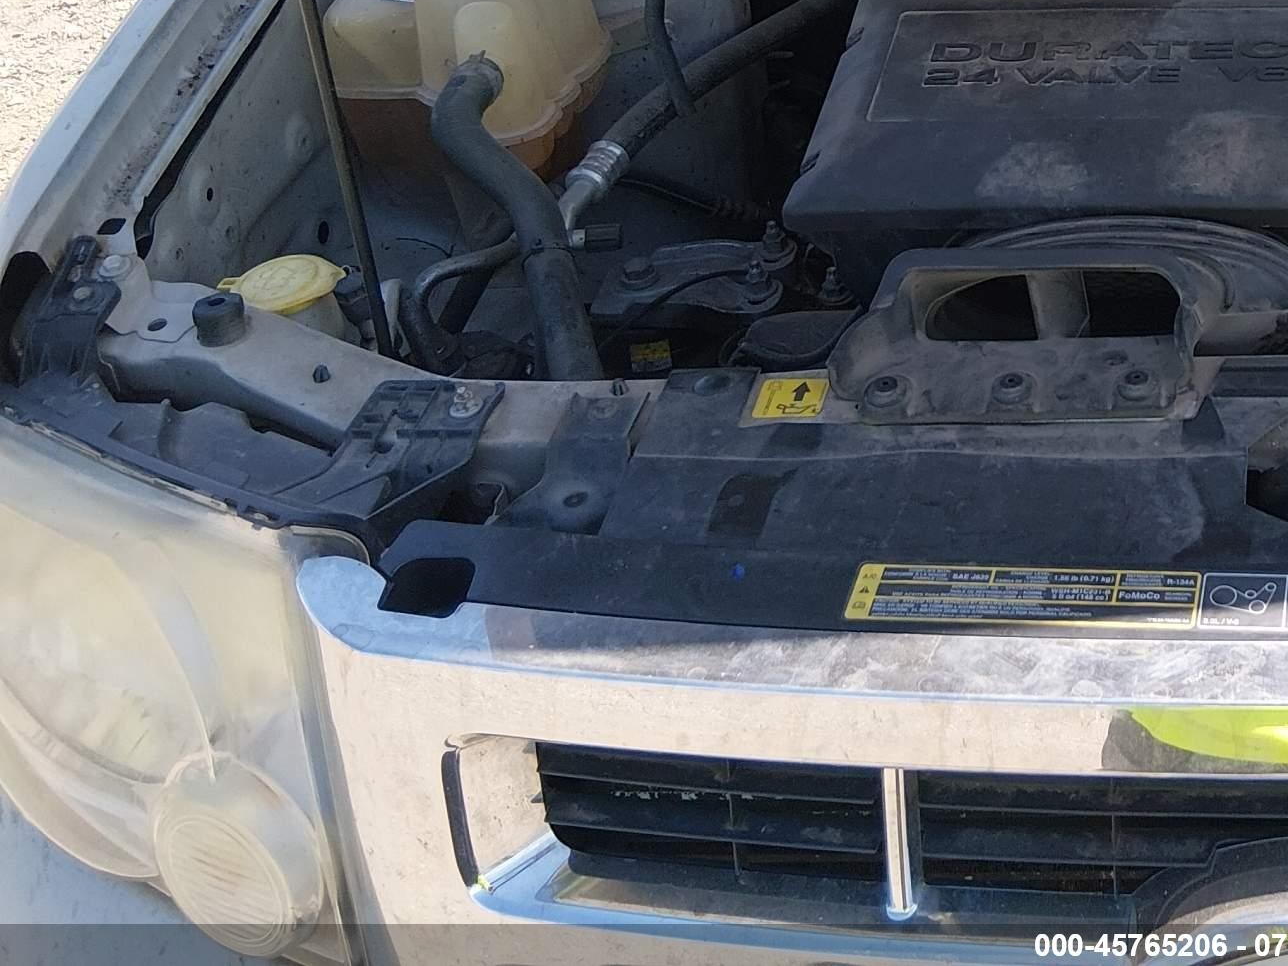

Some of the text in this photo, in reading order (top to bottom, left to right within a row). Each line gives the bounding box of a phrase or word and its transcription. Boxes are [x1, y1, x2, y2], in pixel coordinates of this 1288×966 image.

[922, 66, 999, 86] 24
[1015, 65, 1181, 85] VALVE
[952, 572, 969, 580] SAE
[1101, 575, 1115, 584] kg)
[1119, 591, 1161, 600] FoMoCo
